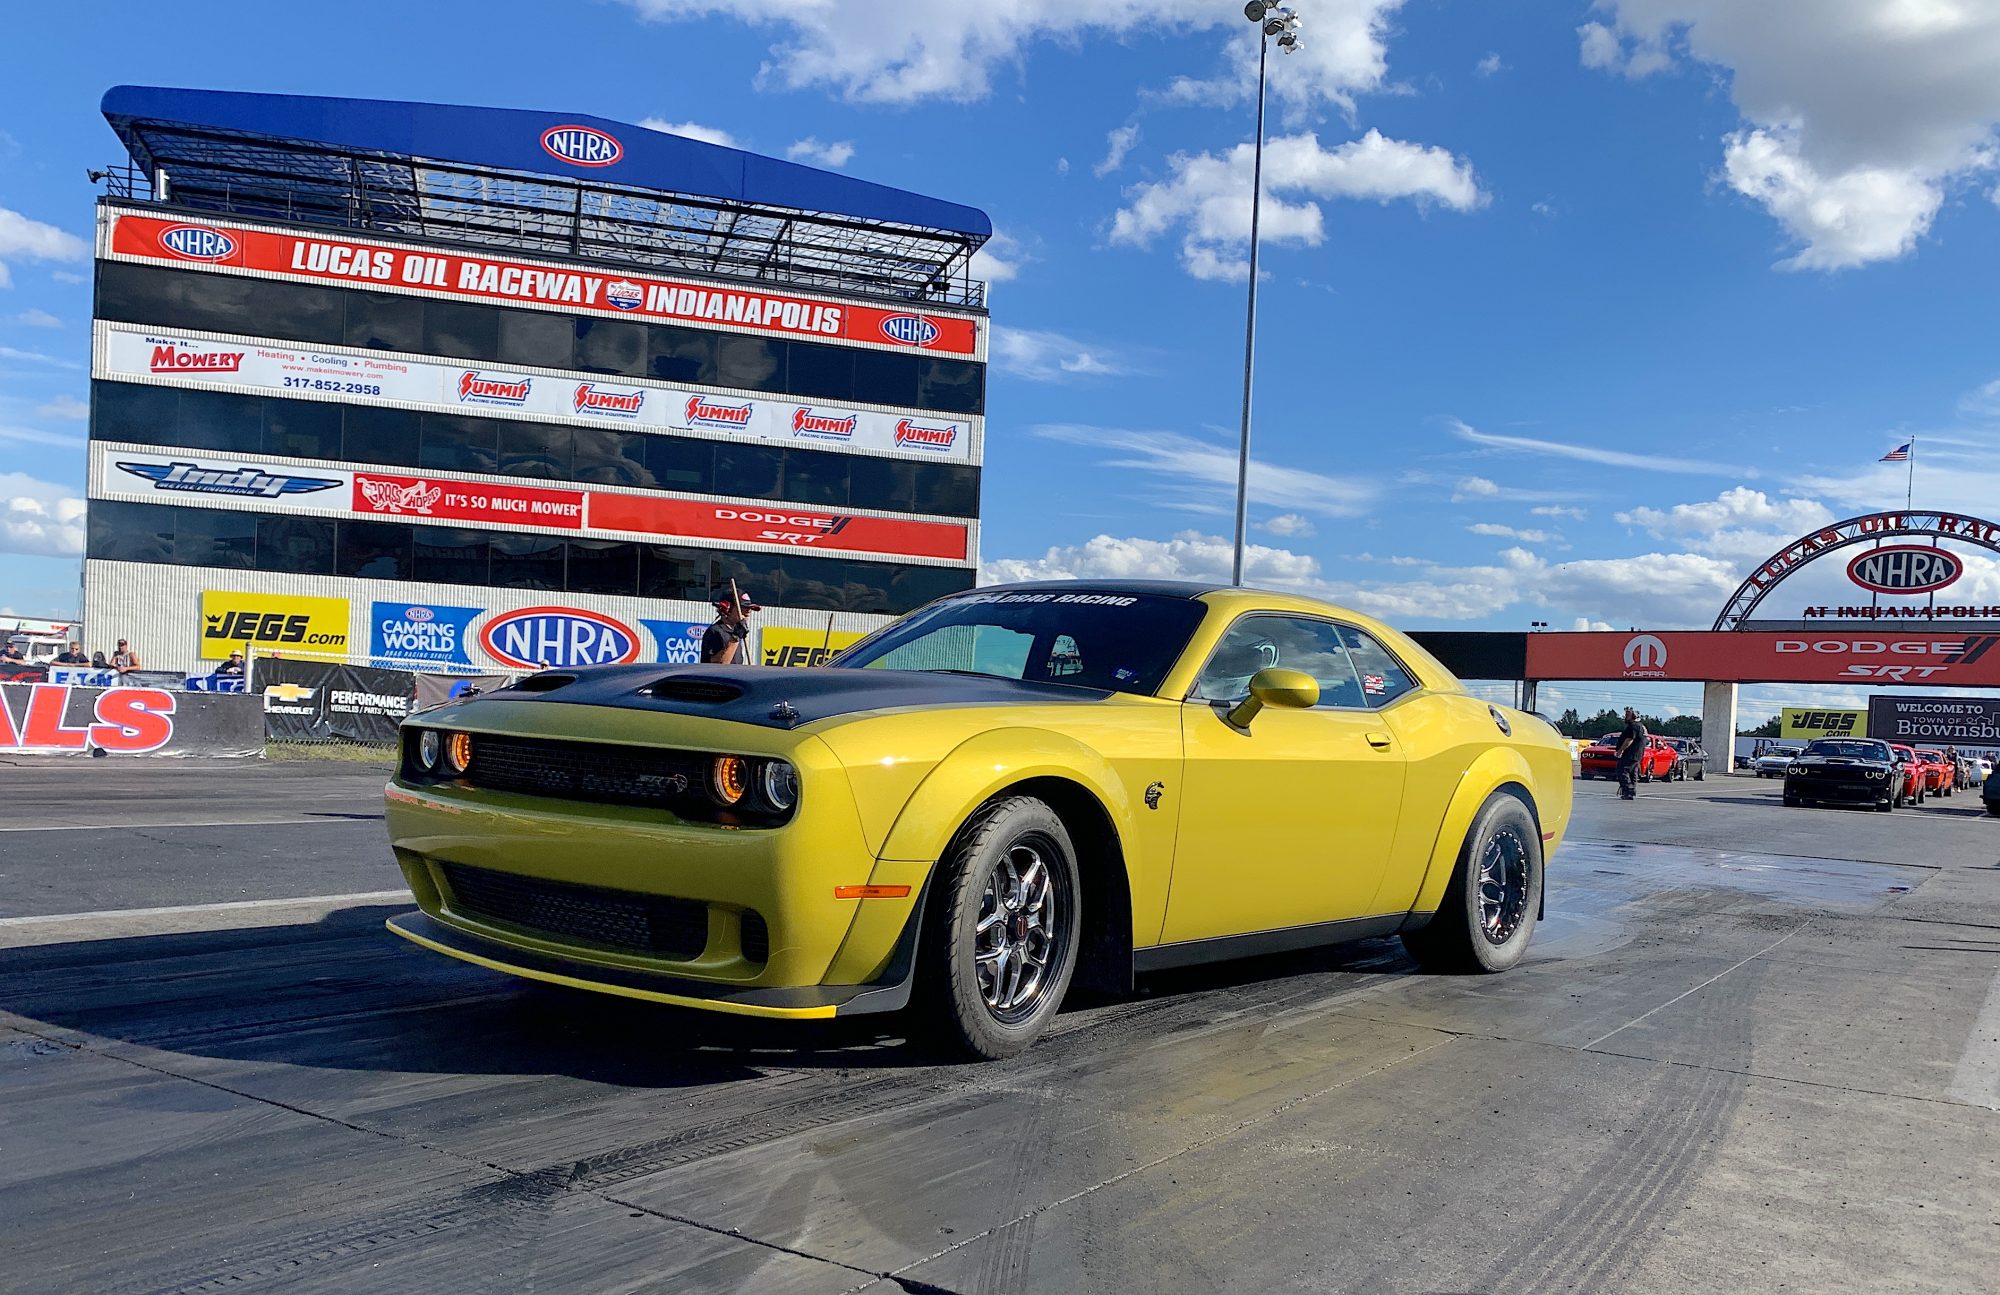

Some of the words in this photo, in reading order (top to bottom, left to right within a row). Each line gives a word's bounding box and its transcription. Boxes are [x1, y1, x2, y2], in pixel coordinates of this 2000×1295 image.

[548, 130, 612, 161] NHRA
[171, 229, 227, 256] NHRA
[290, 241, 394, 280] LUCAS
[402, 255, 448, 287] OIL
[457, 261, 603, 305] RACEWAY
[611, 289, 640, 298] LUCAS
[645, 285, 841, 334] INDIANAPOLIS
[888, 317, 934, 340] NHRA
[145, 337, 176, 346] Make
[149, 346, 245, 372] MOWERY
[257, 350, 295, 362] Heating
[311, 354, 348, 368] Cooling
[364, 361, 407, 373] Plumbing
[282, 364, 384, 380] www.makeitmowery.com
[284, 376, 381, 396] 317-852-2958
[162, 465, 289, 494] Indy
[445, 493, 468, 508] IT'S
[470, 496, 487, 509] SO
[491, 498, 527, 512] MUCH
[715, 509, 834, 529] DODGE
[756, 530, 824, 545] SRT
[1750, 528, 1839, 591] LUCAS
[1859, 515, 1910, 534] OIL
[1864, 552, 1948, 588] NHRA
[1052, 594, 1138, 607] RACING
[408, 610, 431, 619] NHRA
[1803, 606, 1827, 618] AT
[205, 611, 346, 646] JEGS.com
[382, 620, 455, 637] CAMPING
[382, 633, 455, 653] WORLD
[505, 618, 619, 667] NHRA
[1775, 640, 1966, 655] DODGE
[1838, 664, 1949, 682] SRT
[330, 690, 407, 709] PERFORMANCE
[331, 704, 359, 713] VEHICLES
[1896, 703, 1964, 714] WELCOME
[1965, 704, 1984, 714] TO
[1791, 712, 1858, 730] JEGS
[1913, 716, 1944, 724] TOWN
[1947, 717, 1962, 725] OF
